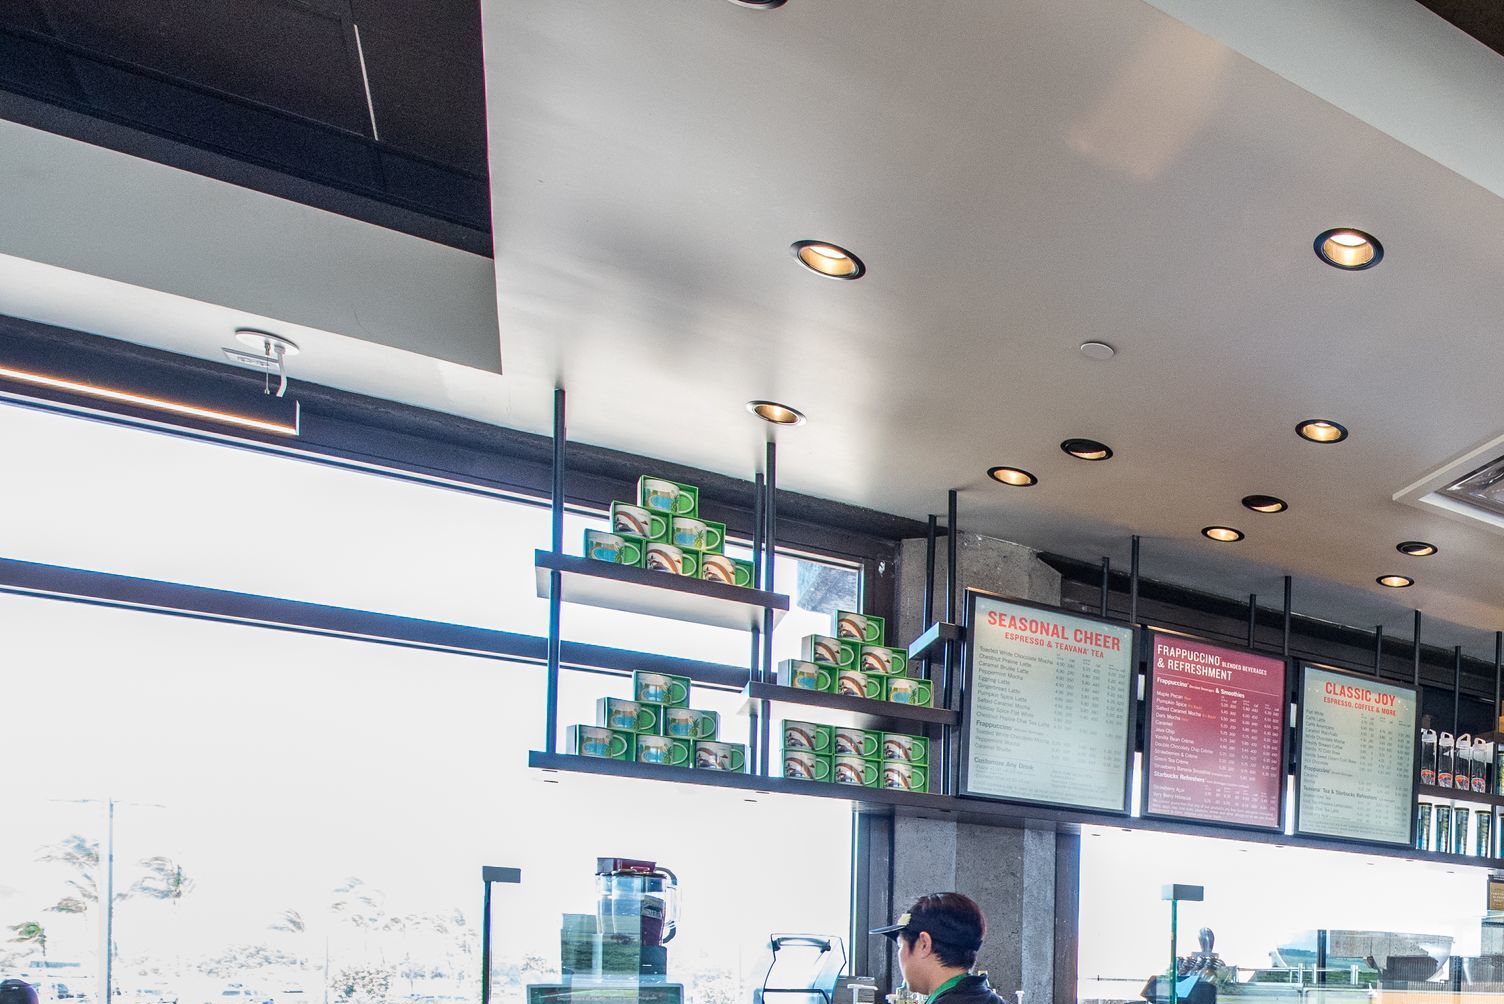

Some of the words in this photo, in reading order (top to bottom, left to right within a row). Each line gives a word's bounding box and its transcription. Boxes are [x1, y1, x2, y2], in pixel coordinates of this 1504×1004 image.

[988, 611, 1068, 641] SEASONAL
[1074, 629, 1120, 651] CHEER
[1005, 632, 1044, 646] ESPRESSO
[1158, 645, 1220, 666] FRAPPUCCINO
[1222, 662, 1241, 670] BLENDED
[1243, 666, 1267, 676] BEVERAGES
[1158, 658, 1165, 668] &
[1168, 660, 1232, 680] REFRESHMENT
[1221, 689, 1245, 699] Smoothies
[1325, 681, 1371, 702] CLASSIC
[1375, 692, 1396, 706] JOY
[1355, 702, 1374, 712] COFFEE
[1382, 706, 1396, 716] MORE
